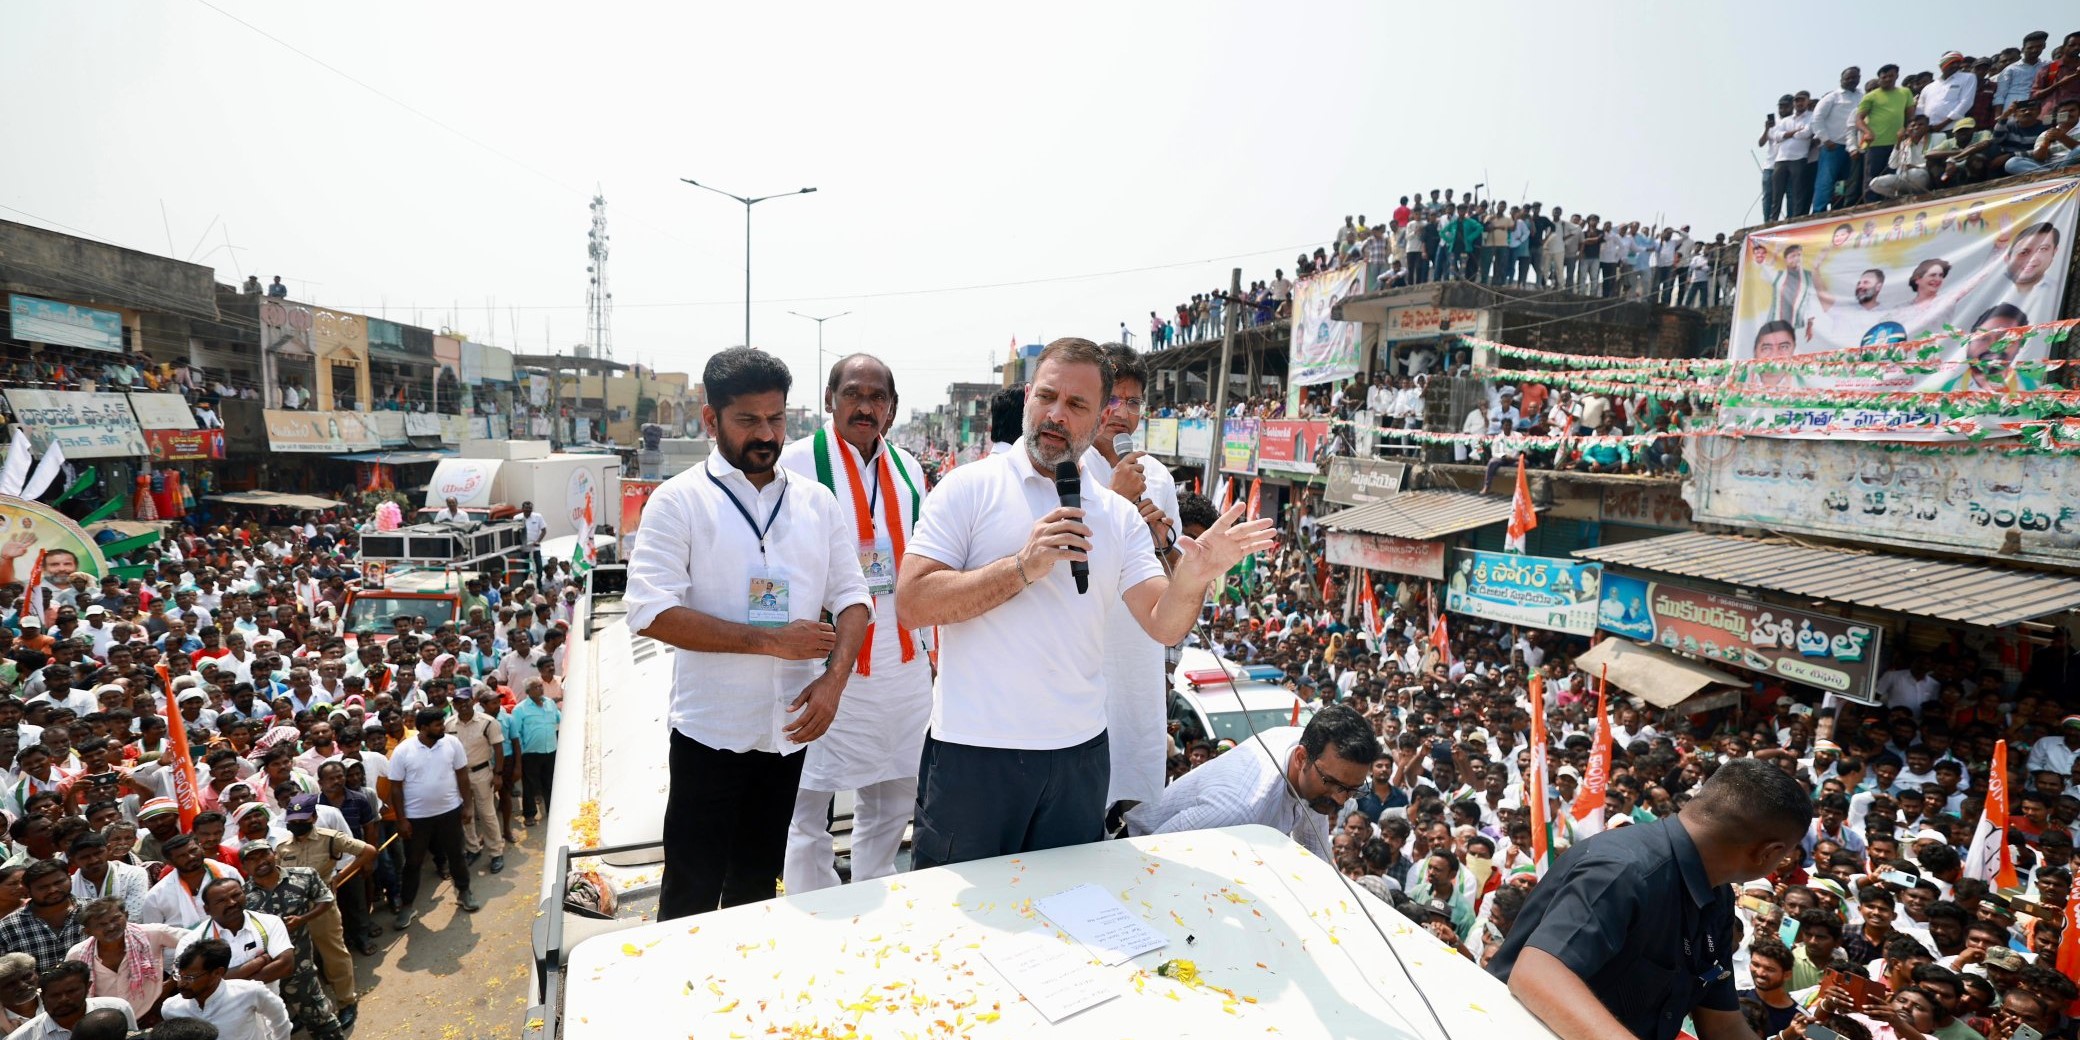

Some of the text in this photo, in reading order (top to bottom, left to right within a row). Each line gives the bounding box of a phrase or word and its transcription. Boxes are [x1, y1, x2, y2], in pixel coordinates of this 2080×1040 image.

[19, 404, 79, 426] బాలాజీ
[1473, 560, 1548, 588] శ్రీ సాగర్
[1656, 595, 1871, 660] ముకుందమ్మ హోటల్
[1706, 934, 1715, 952] CRPF
